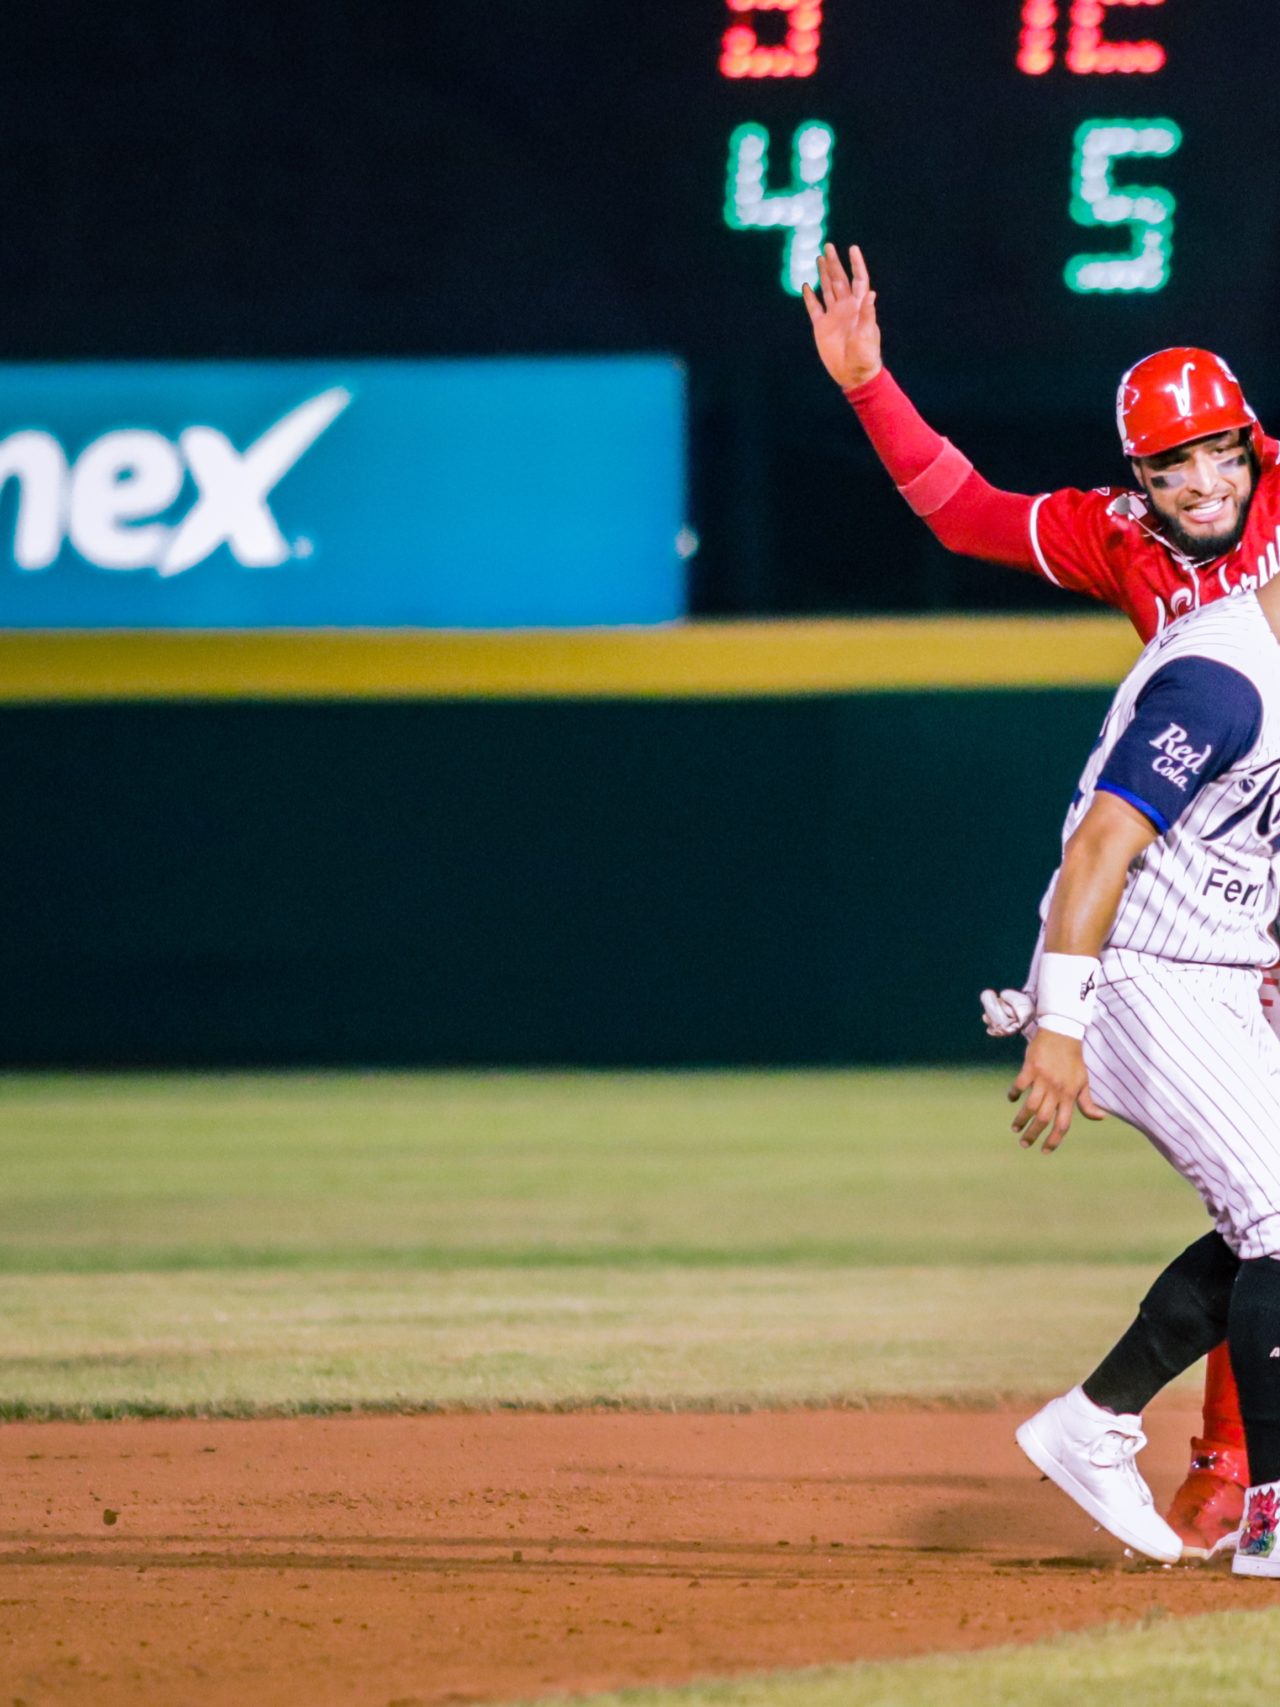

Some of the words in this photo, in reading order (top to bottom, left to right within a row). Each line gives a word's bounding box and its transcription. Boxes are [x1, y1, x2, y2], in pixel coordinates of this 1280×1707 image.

[722, 120, 834, 297] 4
[1063, 117, 1184, 294] 5
[1148, 722, 1212, 775] Red
[1152, 755, 1188, 792] Cola
